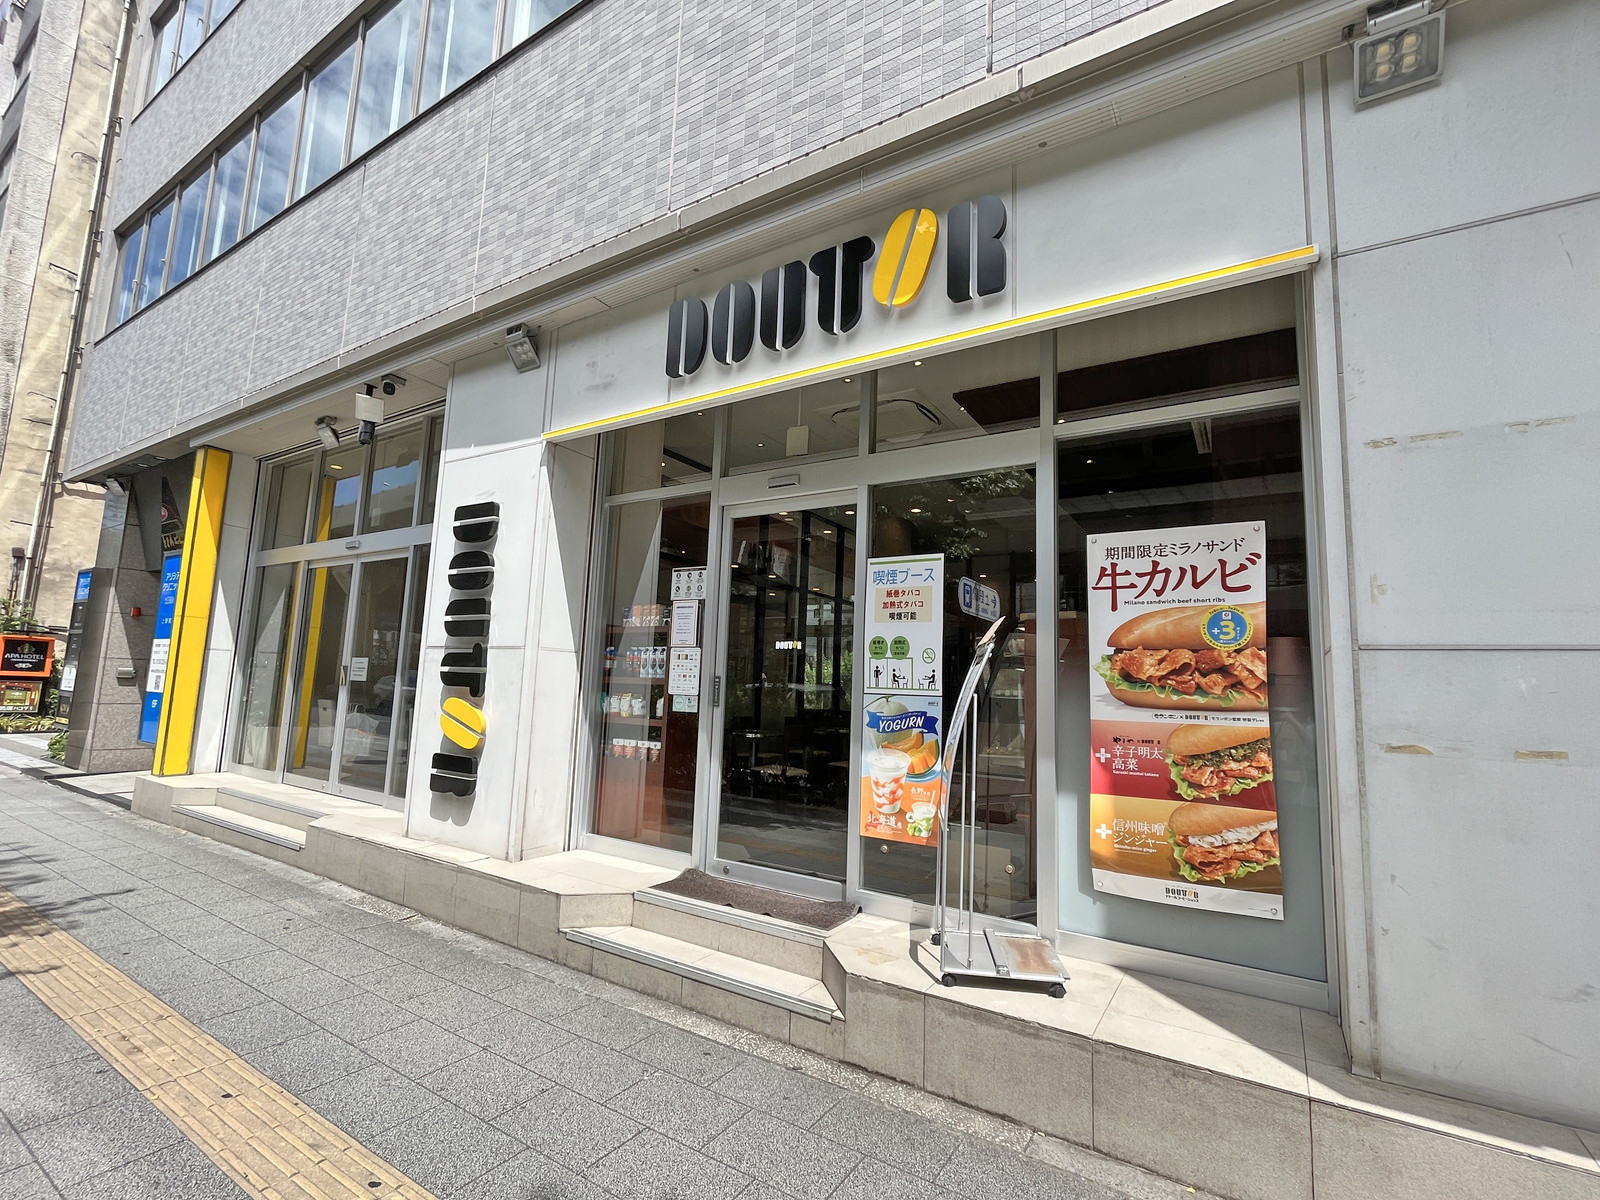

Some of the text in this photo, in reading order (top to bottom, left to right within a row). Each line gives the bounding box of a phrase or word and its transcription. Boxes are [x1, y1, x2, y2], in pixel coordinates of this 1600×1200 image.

[665, 195, 1007, 379] DOUTOR
[1105, 537, 1245, 561] 期間限定ミラノサンド
[872, 568, 935, 585] 喫煙ブース
[1091, 552, 1262, 612] 牛カルビ
[886, 589, 921, 598] 紙巻タバコ
[882, 600, 924, 609] 加熱式タバコ
[888, 611, 917, 621] 喫煙可能
[430, 501, 500, 797] DOUTOR
[879, 716, 925, 732] YOGURN
[1112, 745, 1163, 760] 辛子明太
[1112, 758, 1138, 771] 高菜
[1112, 818, 1166, 836] 信州味噌
[1113, 832, 1168, 847] ジンジャー
